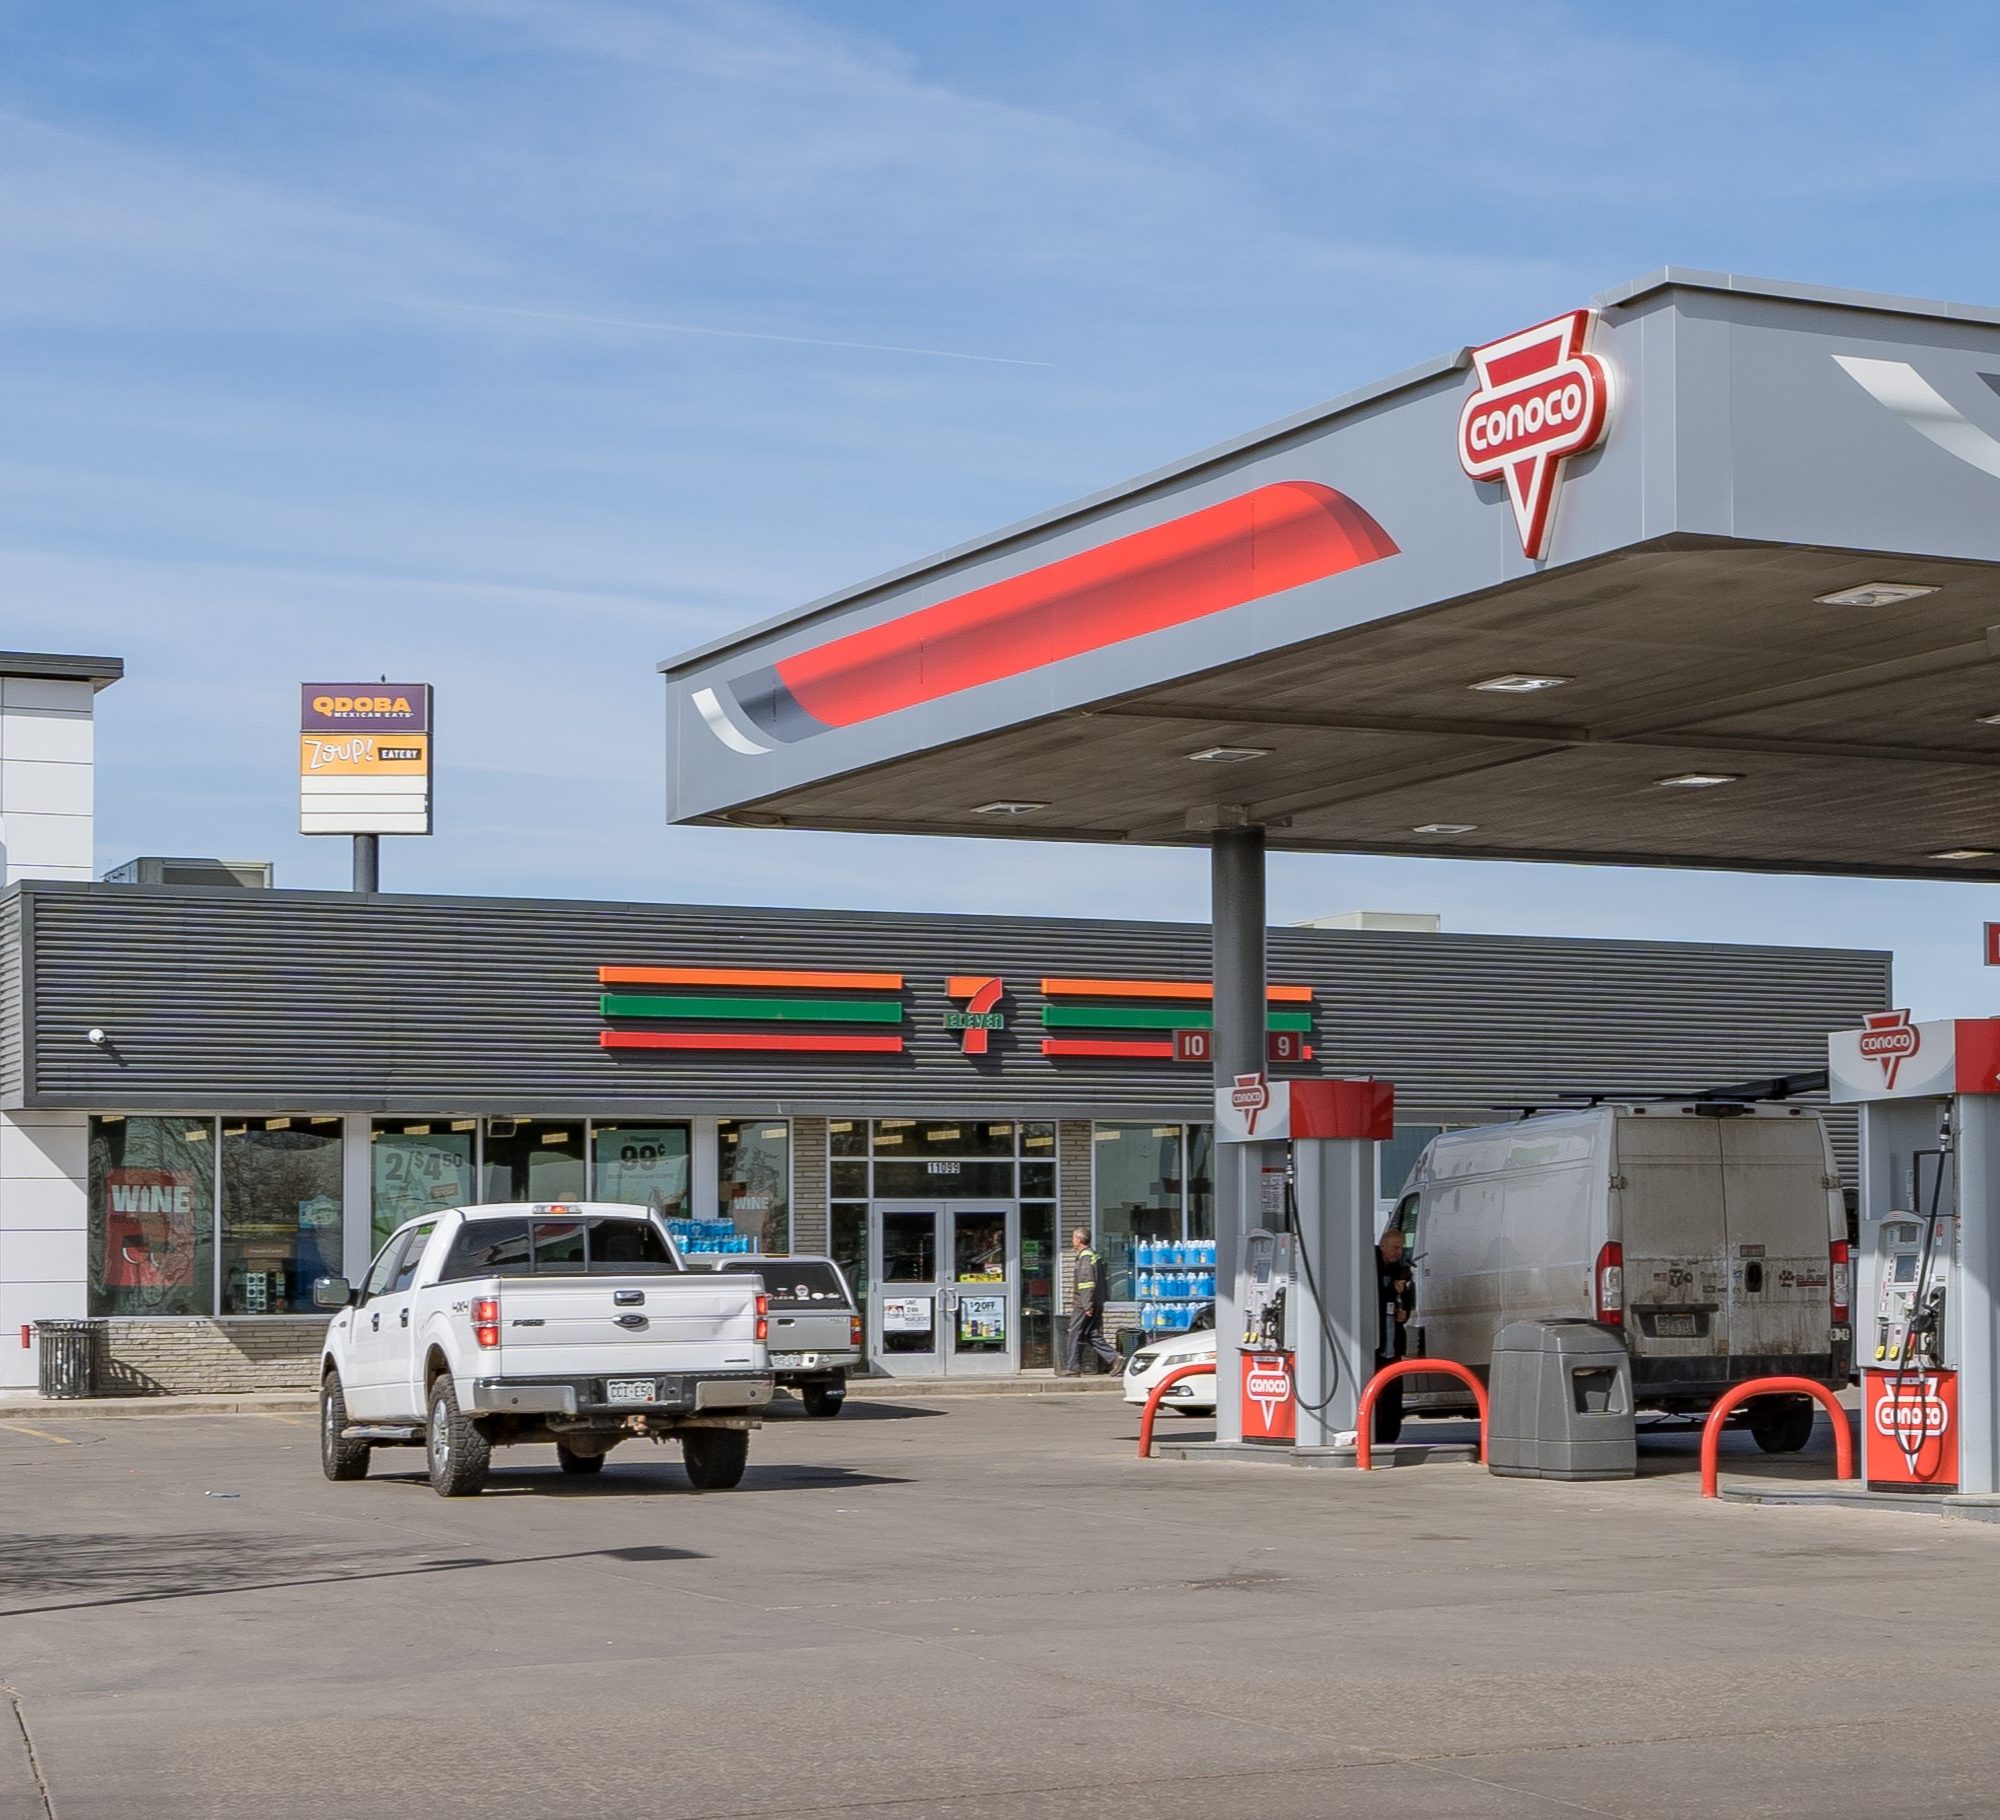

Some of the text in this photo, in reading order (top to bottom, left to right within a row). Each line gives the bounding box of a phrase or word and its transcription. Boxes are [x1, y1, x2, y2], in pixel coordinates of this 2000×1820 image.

[312, 696, 412, 717] QDOBA
[381, 749, 419, 759] EATERY
[944, 975, 1003, 1054] 7
[1184, 1036, 1204, 1056] 10
[1278, 1036, 1290, 1057] 9
[929, 1163, 960, 1173] 11099
[111, 1185, 191, 1213] WINE
[734, 1196, 769, 1210] WINE
[981, 1301, 996, 1310] OFF
